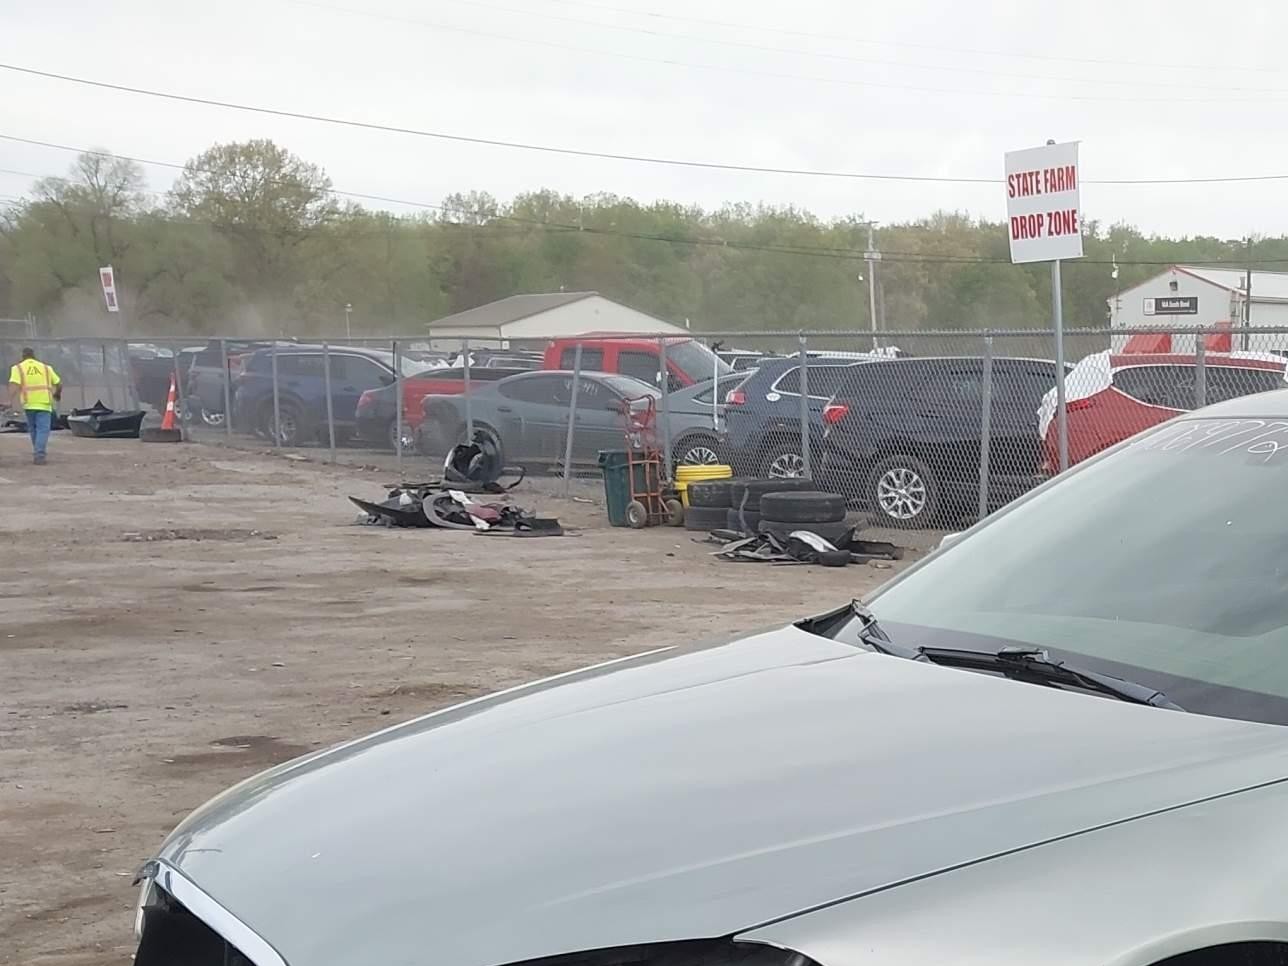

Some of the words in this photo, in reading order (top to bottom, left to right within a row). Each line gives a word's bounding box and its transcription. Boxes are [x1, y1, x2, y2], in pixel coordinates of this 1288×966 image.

[1008, 171, 1041, 198] STATE
[1043, 165, 1076, 193] FARM
[1011, 213, 1044, 240] DROP
[1047, 209, 1078, 236] ZONE
